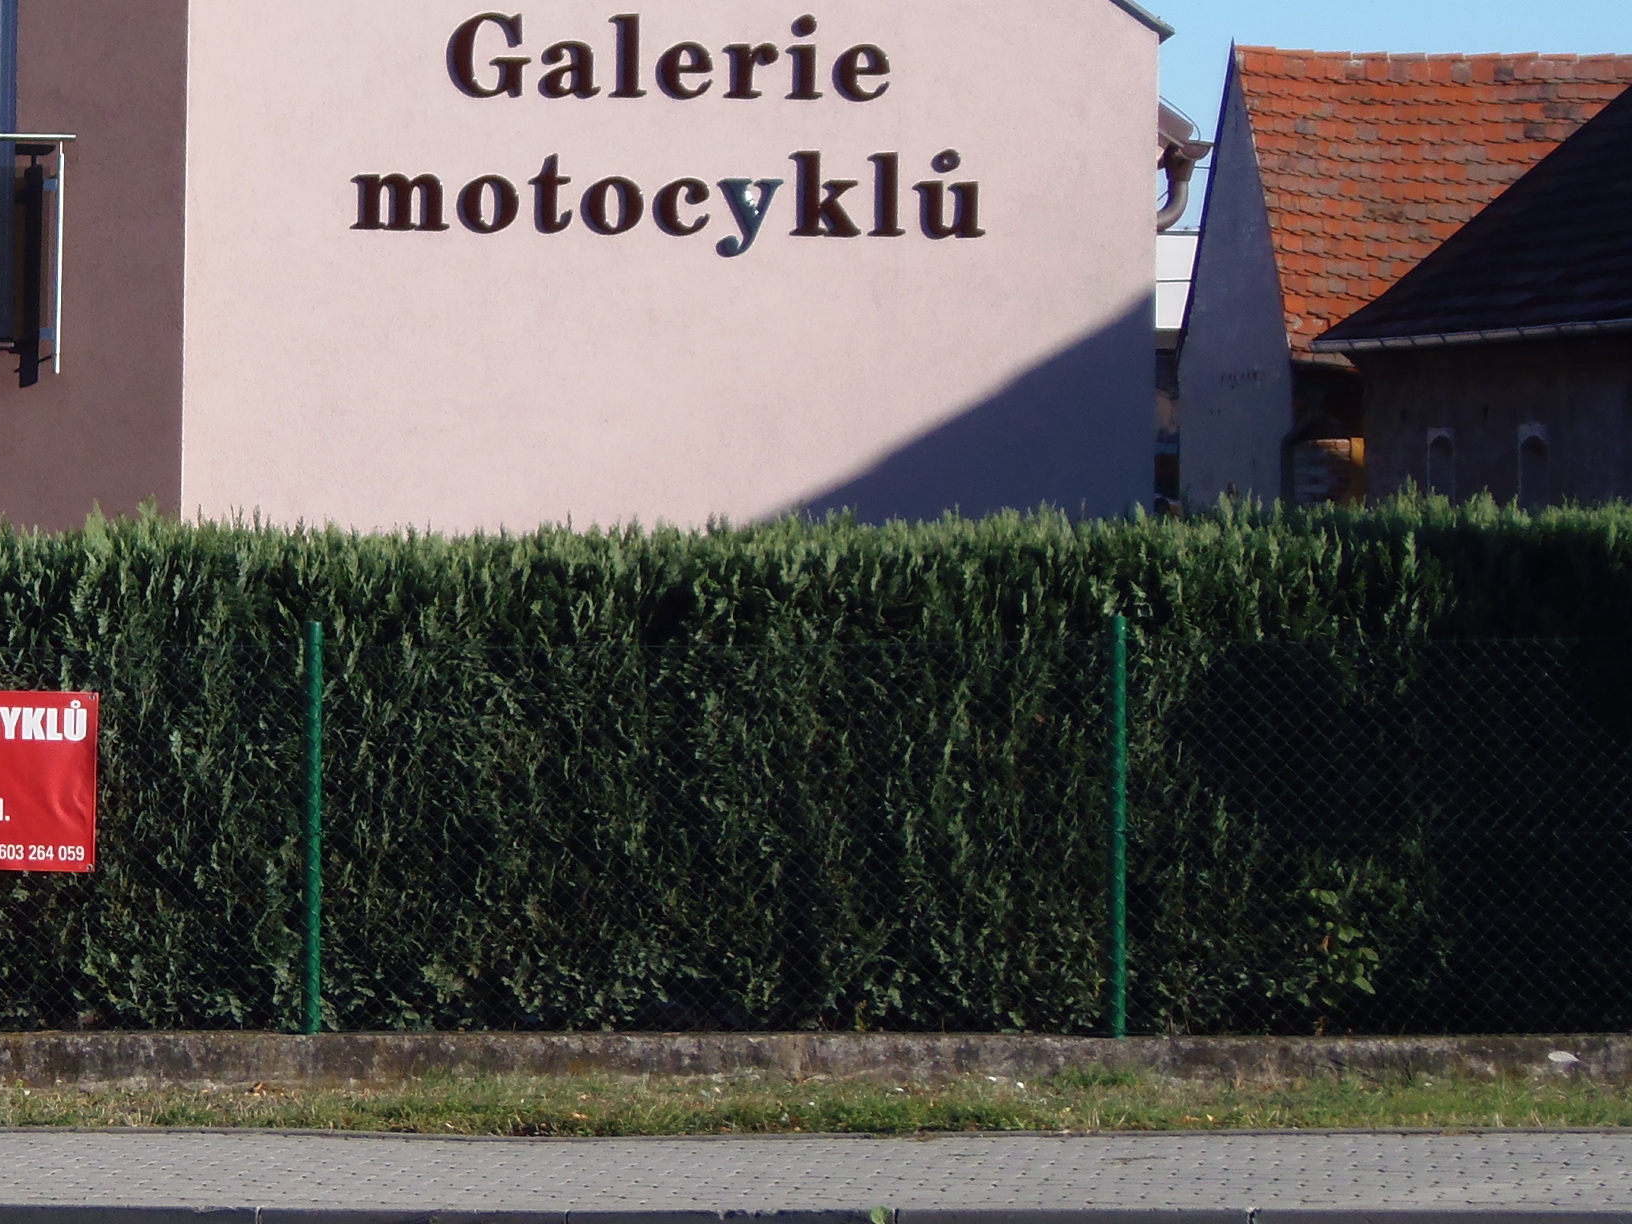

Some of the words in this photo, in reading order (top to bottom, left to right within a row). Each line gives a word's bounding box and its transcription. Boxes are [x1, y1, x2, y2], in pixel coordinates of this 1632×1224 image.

[446, 11, 892, 102] Galerie
[349, 148, 986, 258] motocyklů
[28, 845, 54, 861] 264
[58, 846, 84, 861] 059
